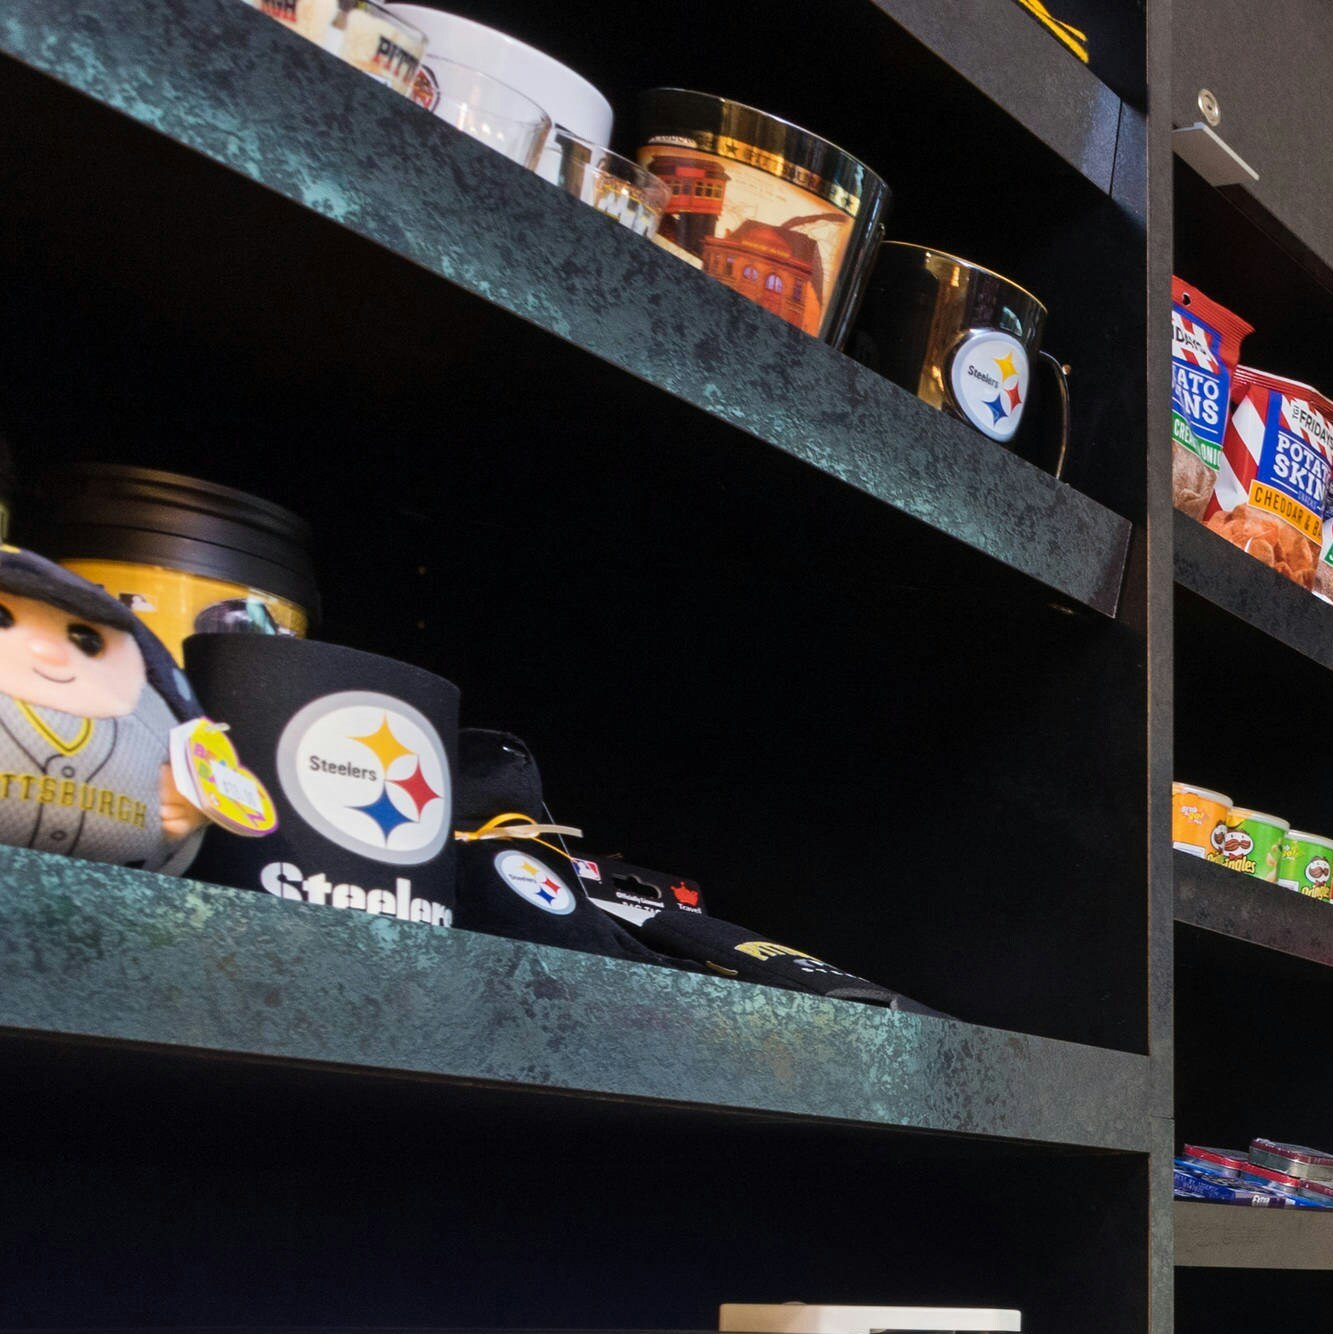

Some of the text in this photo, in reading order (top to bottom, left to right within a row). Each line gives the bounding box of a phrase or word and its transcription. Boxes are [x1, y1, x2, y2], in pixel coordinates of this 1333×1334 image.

[967, 364, 999, 390] Steelers
[1253, 487, 1302, 526] CHEDDAR
[309, 755, 378, 782] Steelers
